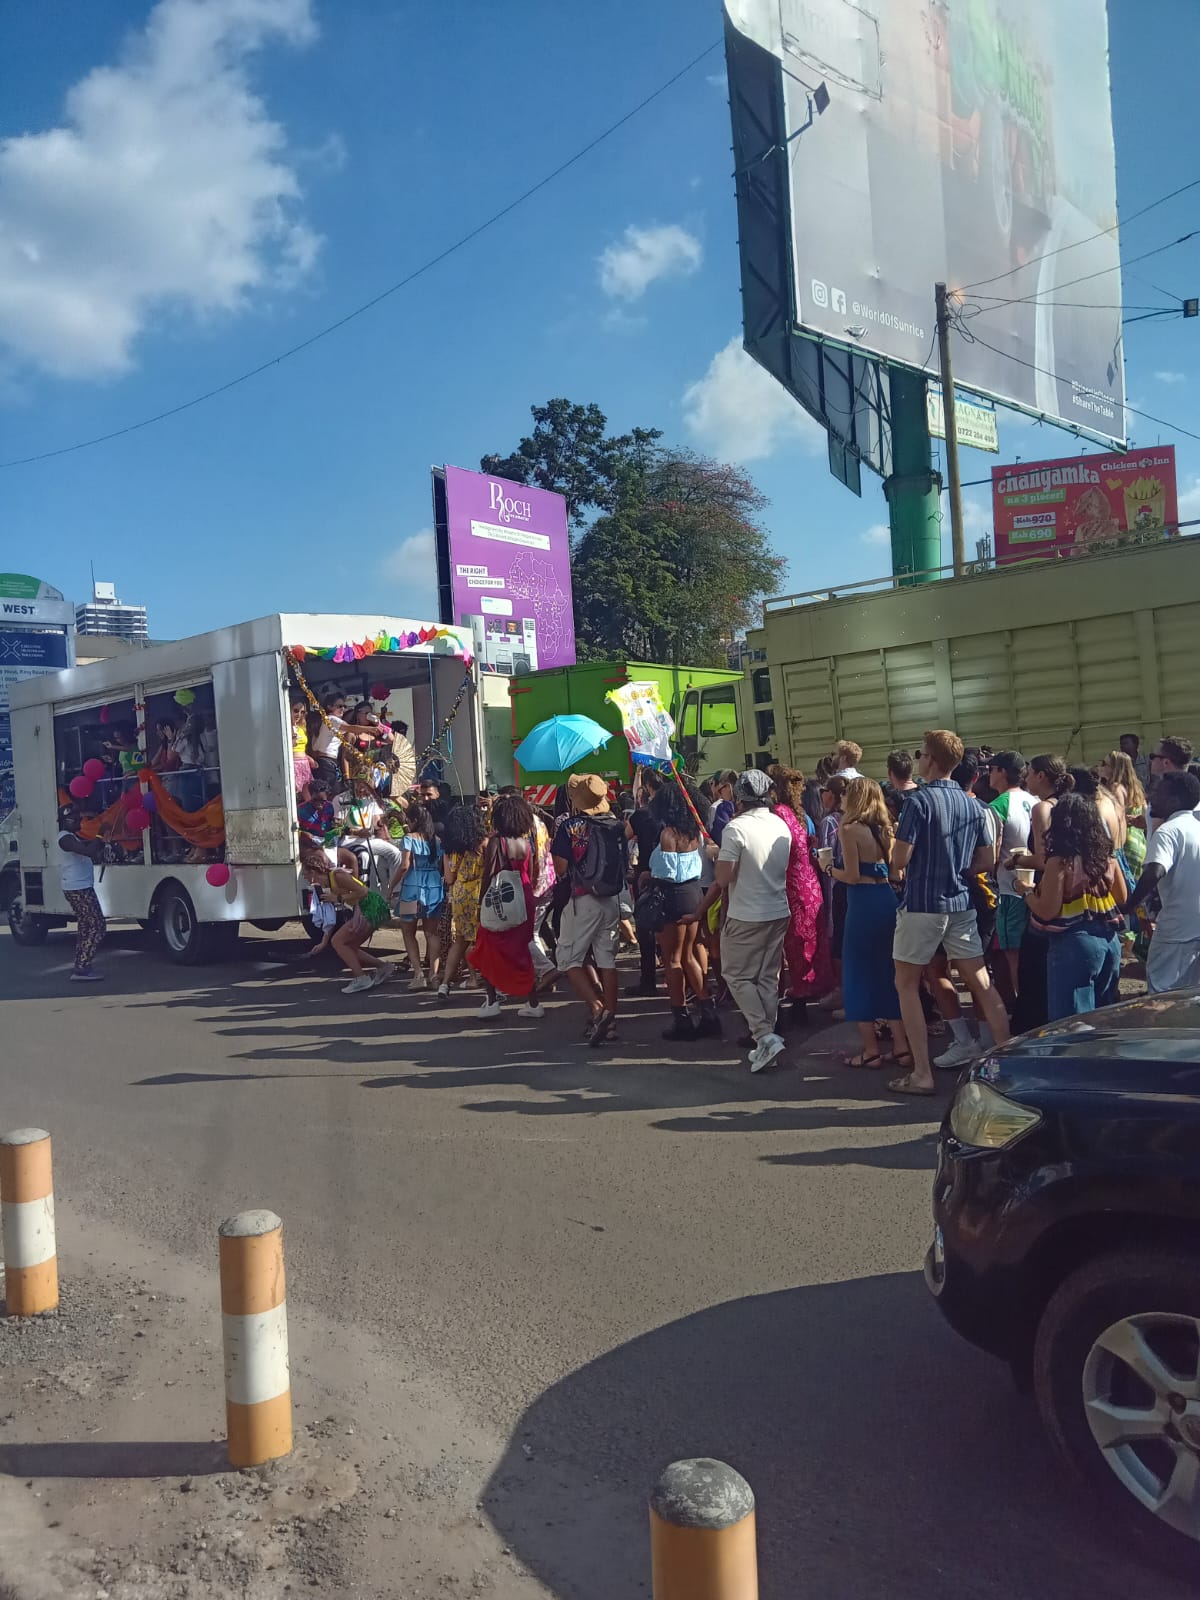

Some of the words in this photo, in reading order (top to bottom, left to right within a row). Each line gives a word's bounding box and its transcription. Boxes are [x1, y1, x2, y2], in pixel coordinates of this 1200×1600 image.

[1101, 461, 1137, 471] Chicken
[1153, 457, 1170, 466] Inn
[488, 481, 531, 522] ROCH
[470, 567, 486, 575] RIGHT
[2, 603, 35, 615] WEST
